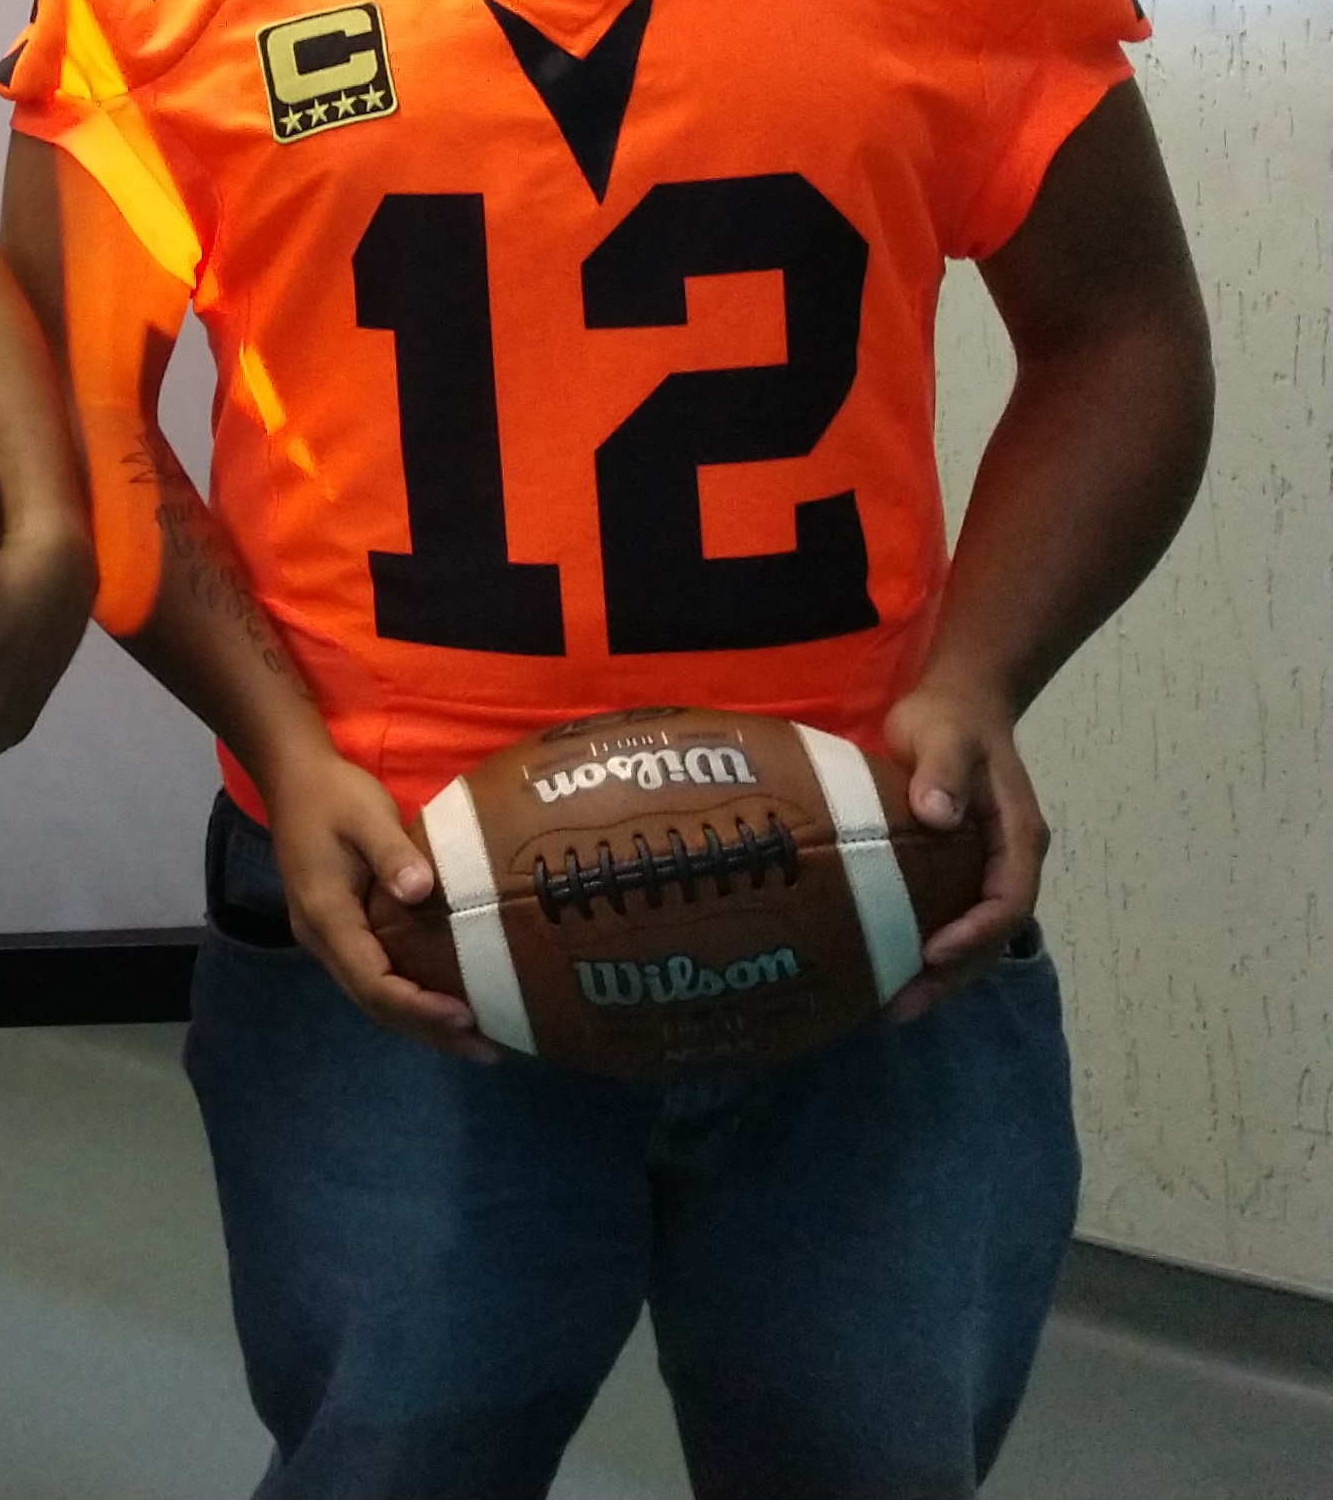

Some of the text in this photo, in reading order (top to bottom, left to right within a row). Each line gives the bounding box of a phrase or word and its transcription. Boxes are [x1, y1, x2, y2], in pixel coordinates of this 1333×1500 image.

[266, 6, 379, 104] C
[351, 172, 880, 656] 12
[533, 746, 757, 803] Wilson
[573, 946, 800, 1006] Wilson
